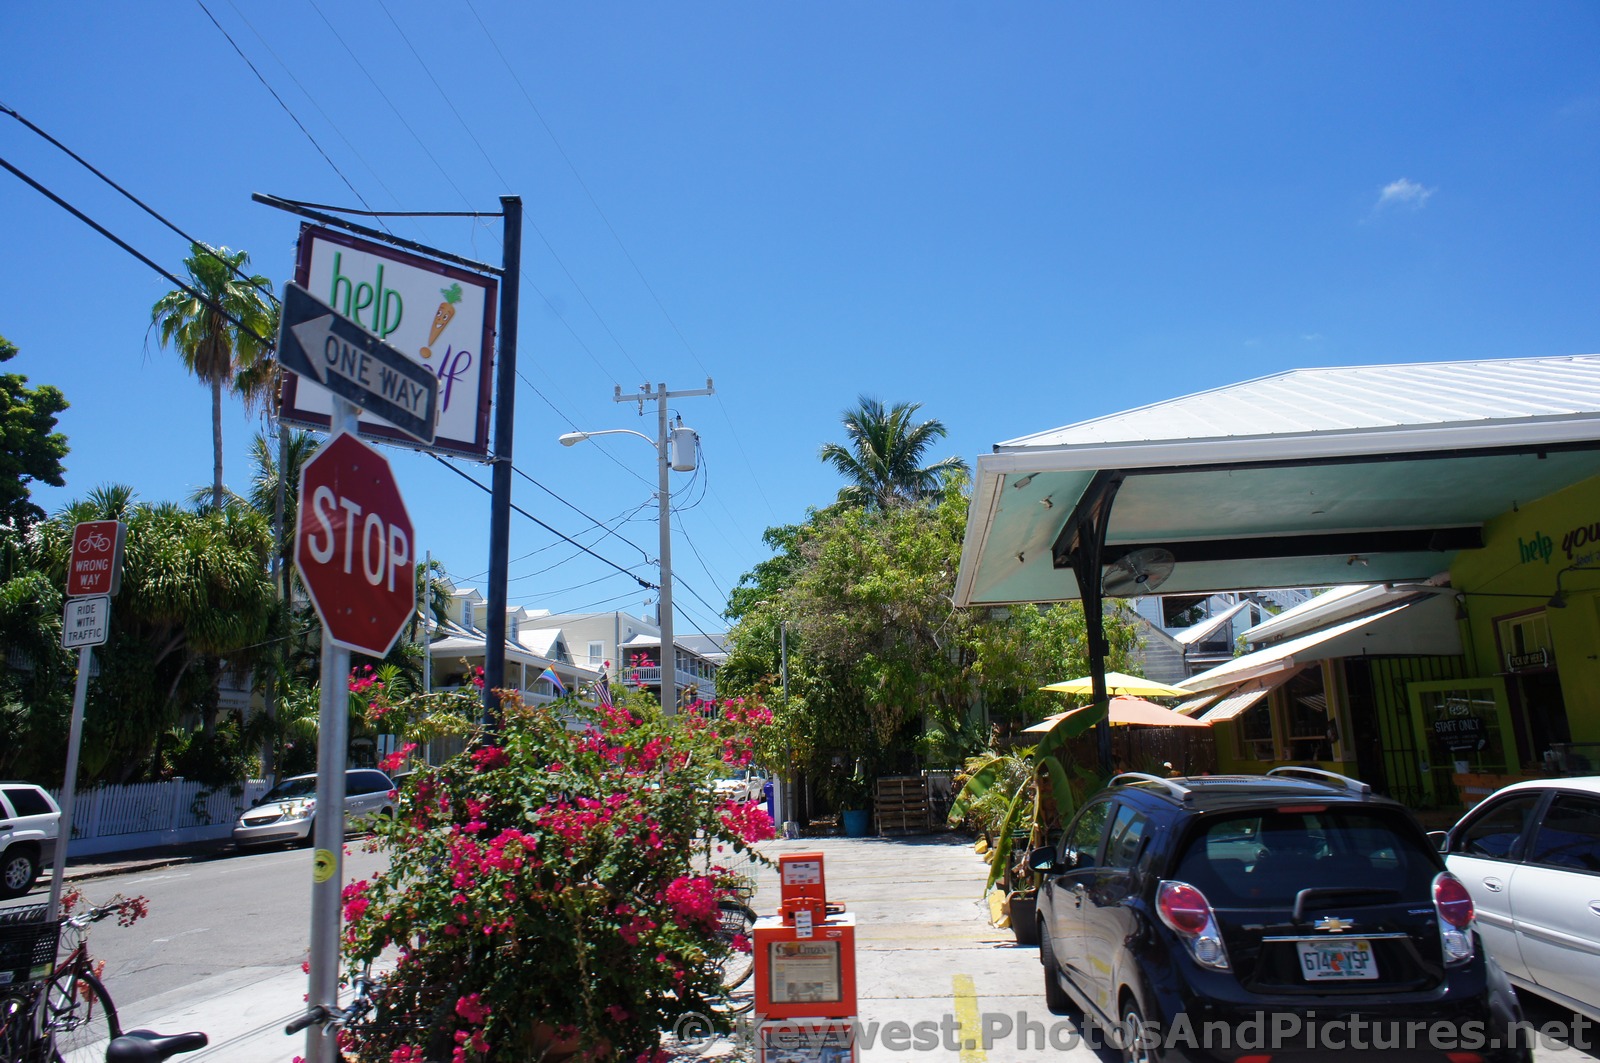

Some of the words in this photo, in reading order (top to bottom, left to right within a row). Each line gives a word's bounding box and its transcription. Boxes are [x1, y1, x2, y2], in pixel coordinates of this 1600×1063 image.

[329, 251, 404, 340] help
[324, 335, 375, 386] ONE
[380, 366, 425, 412] WAY
[307, 485, 410, 593] STOP
[1518, 530, 1553, 565] help
[75, 559, 109, 572] WRONG
[80, 573, 101, 586] WAY
[77, 604, 96, 616] RIDE
[76, 617, 96, 628] WITH
[68, 628, 102, 642] TRAFFIC
[1434, 720, 1457, 733] STAFF
[1459, 719, 1480, 731] ONLY
[1304, 952, 1331, 971] 674
